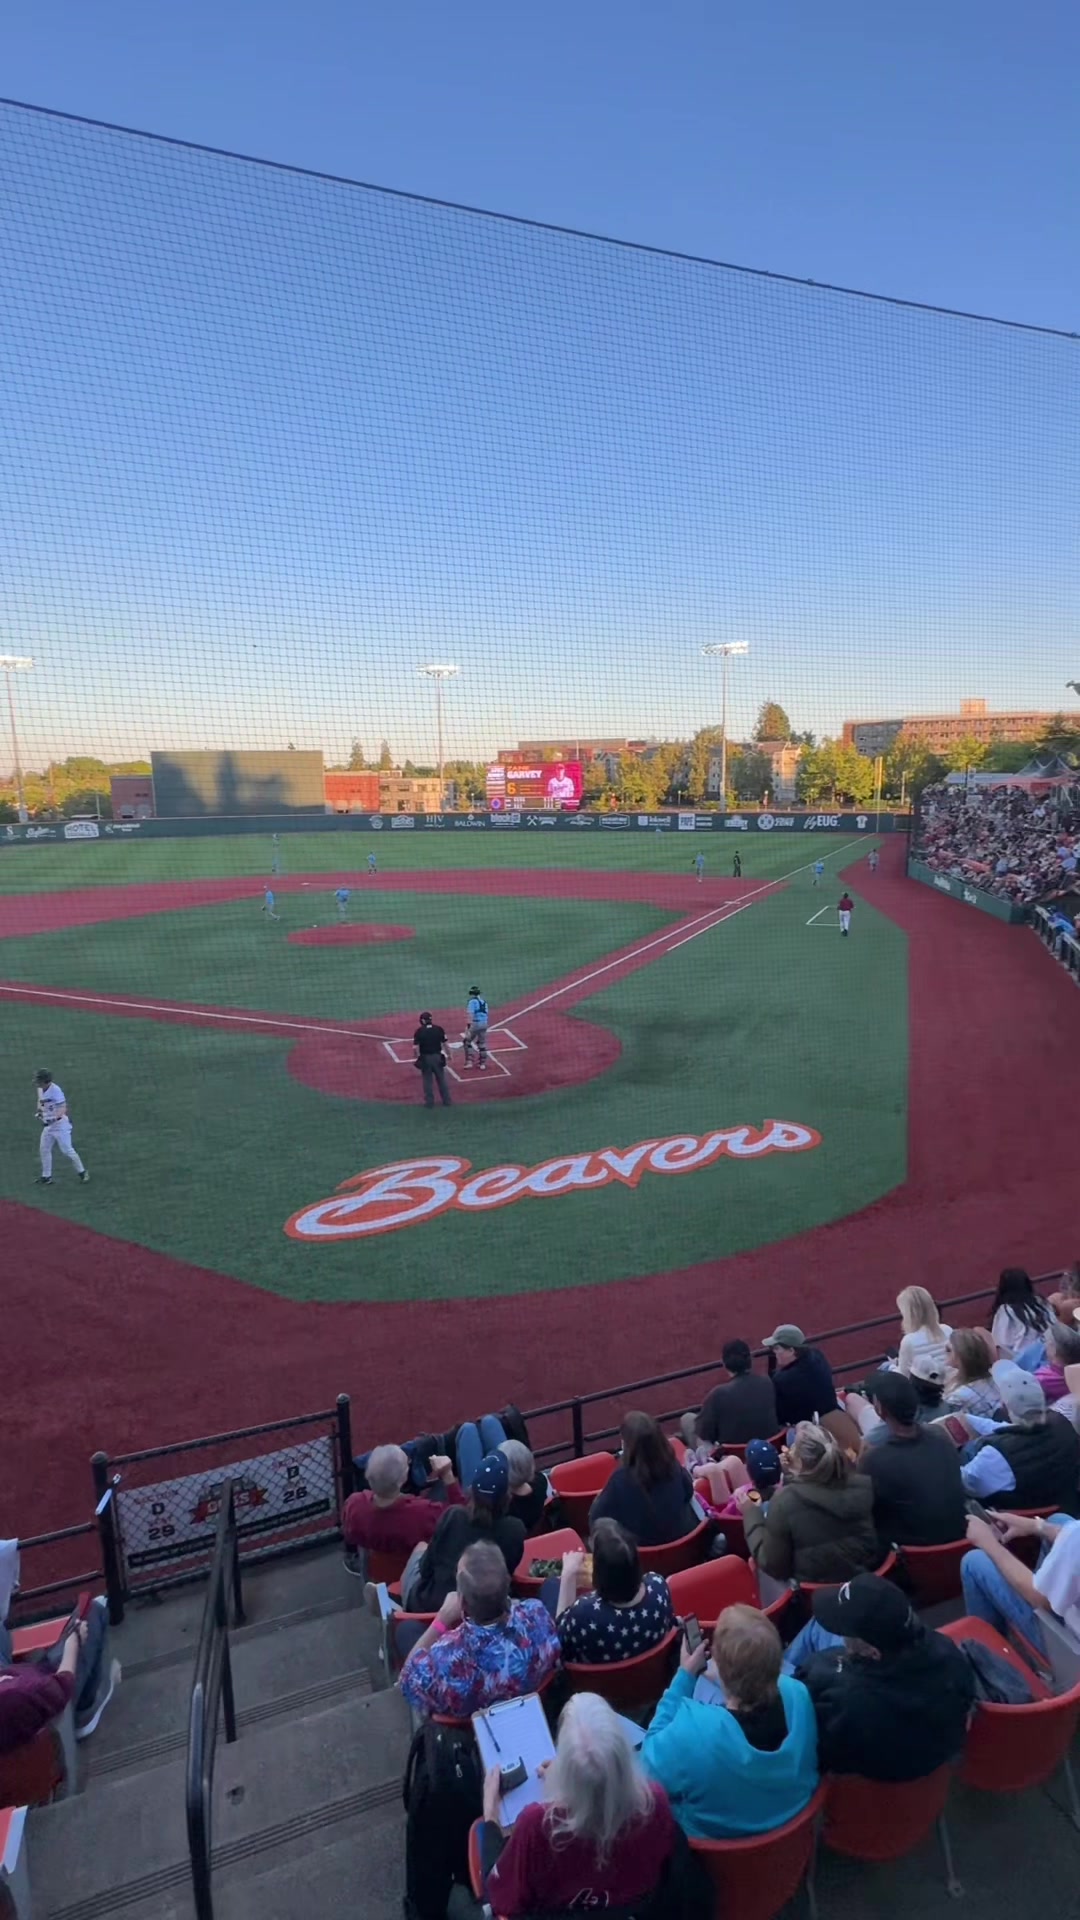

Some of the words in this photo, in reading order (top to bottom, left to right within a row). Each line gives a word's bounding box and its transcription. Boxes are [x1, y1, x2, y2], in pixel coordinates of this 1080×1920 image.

[507, 782, 516, 795] 6
[284, 1118, 822, 1242] Beavers
[283, 1486, 308, 1504] 26
[151, 1502, 165, 1515] D
[148, 1525, 176, 1541] 29
